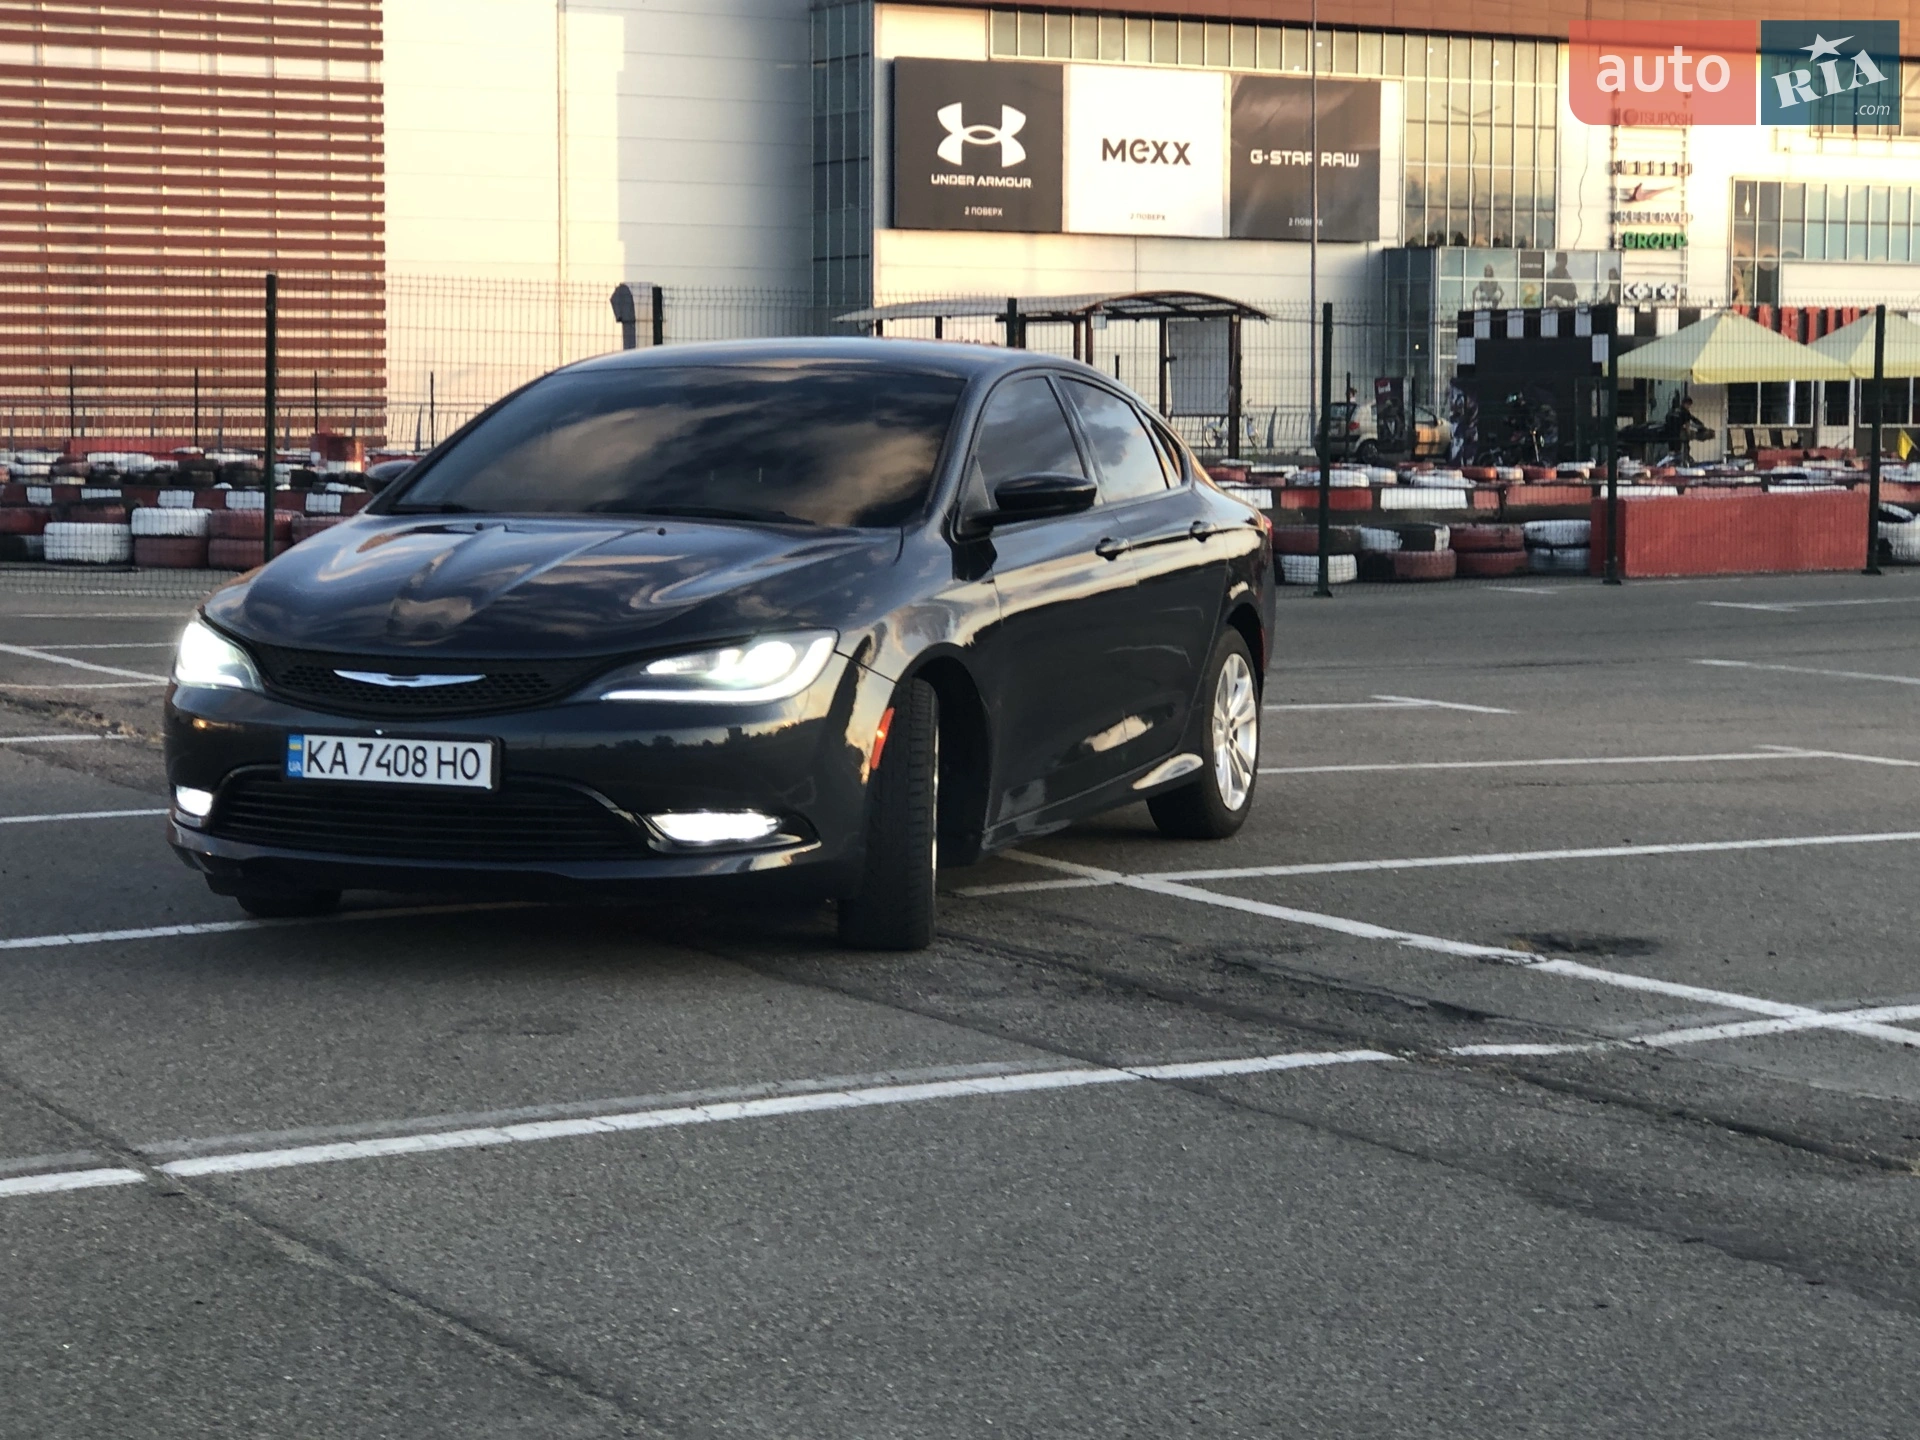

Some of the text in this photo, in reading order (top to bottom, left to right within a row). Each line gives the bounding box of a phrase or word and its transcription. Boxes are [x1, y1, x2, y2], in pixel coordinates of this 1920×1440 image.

[1321, 152, 1359, 167] RAW
[931, 174, 1032, 188] UNDER ARMOUR
[965, 206, 1003, 216] 2 ПОВЕРХ
[1295, 218, 1323, 227] ПОВХ
[1731, 304, 1876, 346] ARTI
[288, 760, 301, 772] UA
[307, 740, 480, 780] KA 7408 HO
